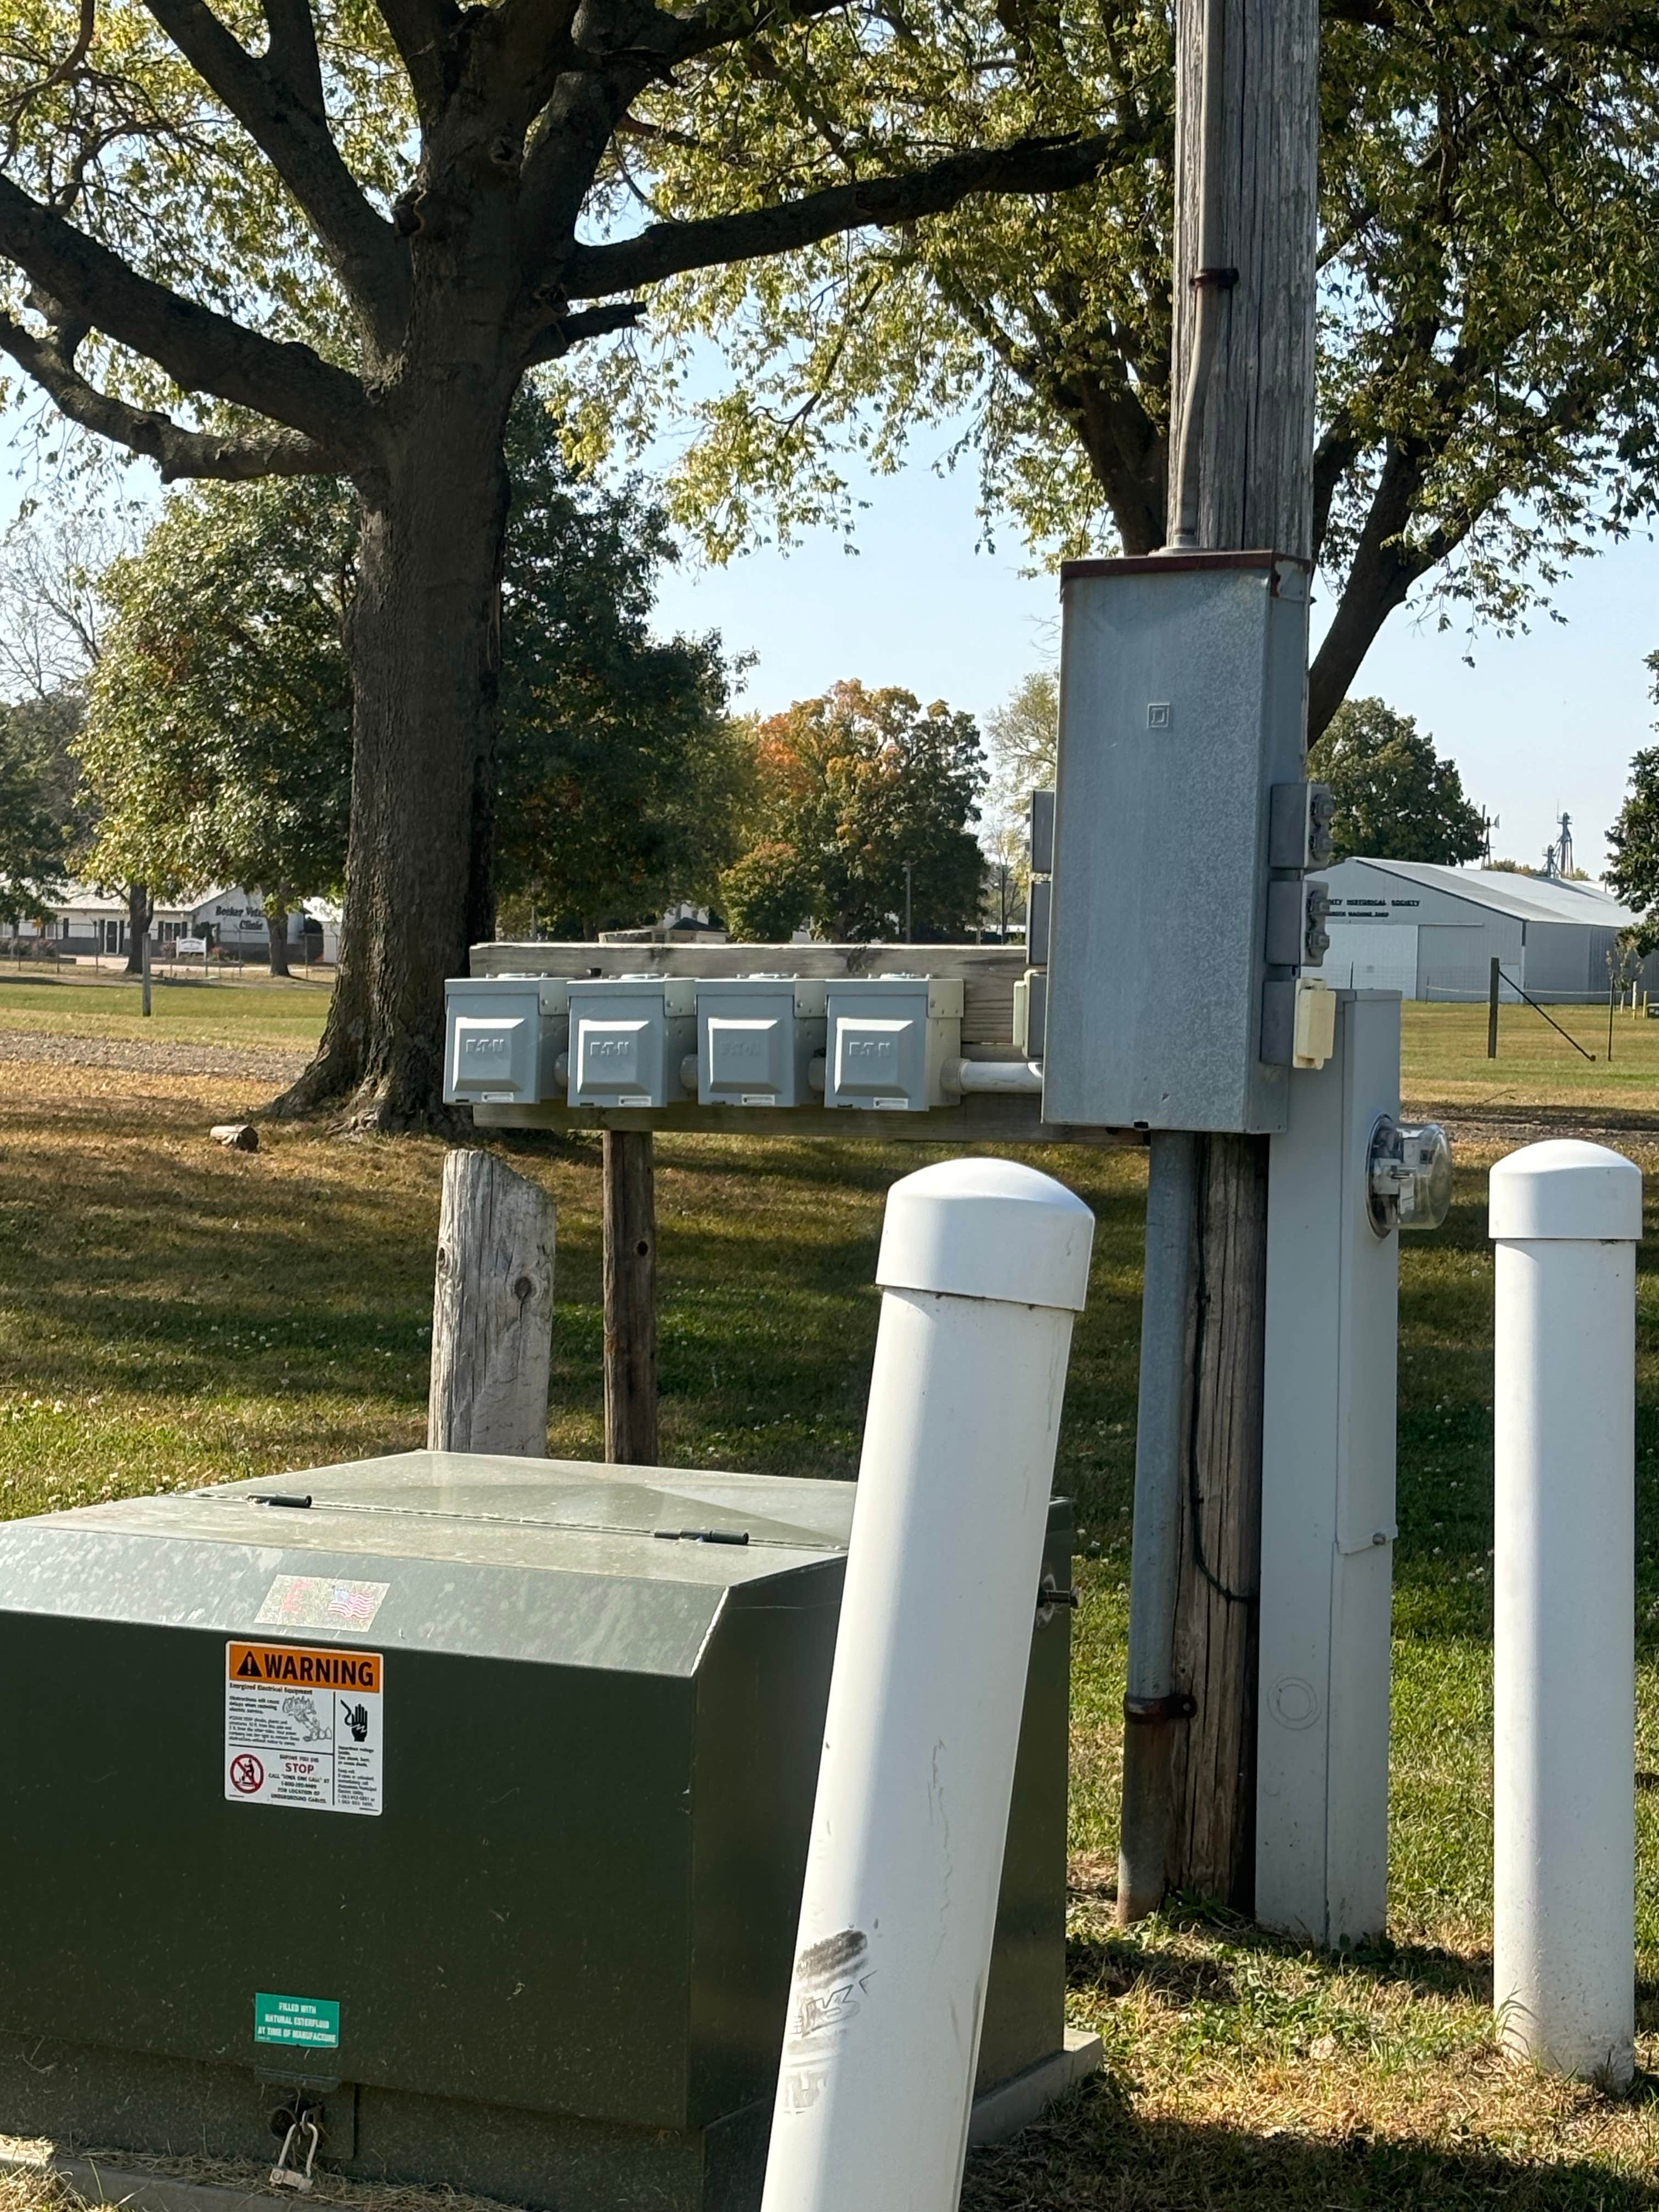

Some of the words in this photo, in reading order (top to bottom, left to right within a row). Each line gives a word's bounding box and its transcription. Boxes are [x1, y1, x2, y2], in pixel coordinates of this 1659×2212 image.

[264, 1653, 374, 1687] WARNING
[229, 1682, 256, 1691] Energized
[257, 1685, 283, 1693] Electrical
[284, 1687, 313, 1695] Equipment
[285, 1763, 314, 1774] STOP
[279, 2001, 300, 2013] FILLED
[301, 2005, 317, 2015] WITH
[265, 2013, 293, 2025] NATURAL
[257, 2025, 266, 2035] AT
[267, 2027, 283, 2037] TIME
[283, 2029, 292, 2038] OF
